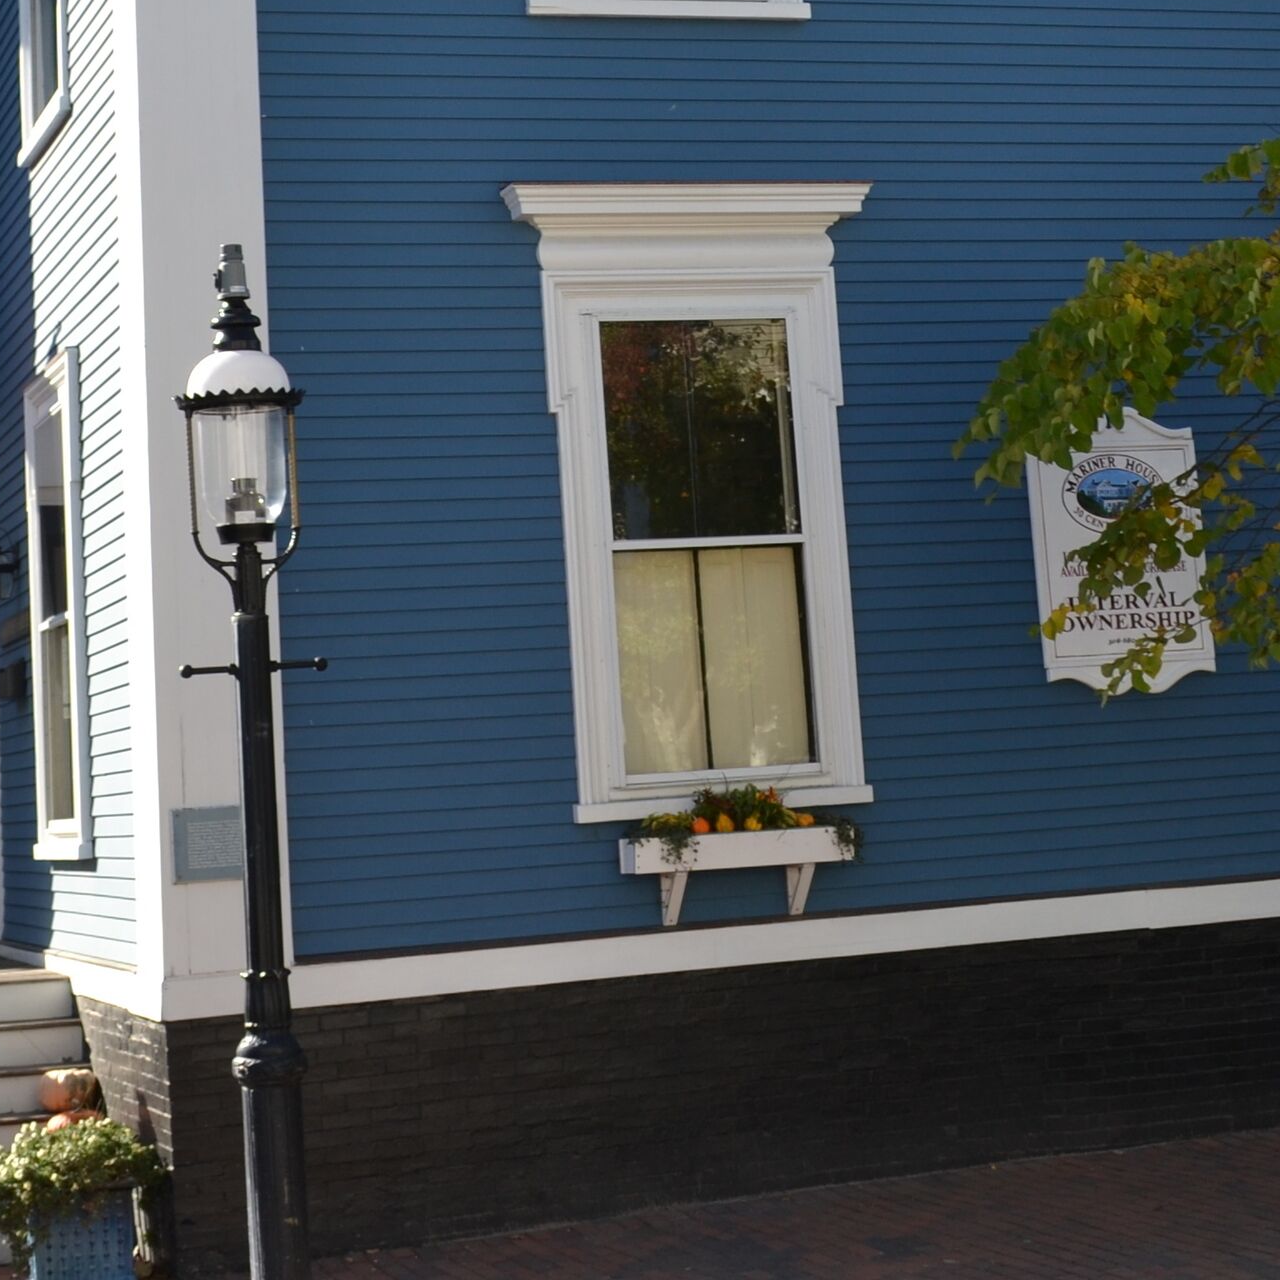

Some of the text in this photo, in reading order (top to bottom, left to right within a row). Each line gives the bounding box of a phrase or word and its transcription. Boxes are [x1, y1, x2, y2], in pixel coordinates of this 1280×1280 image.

[1065, 456, 1159, 494] MARINER HOUS
[1068, 591, 1182, 613] ITERVAL
[1063, 610, 1196, 633] OWNERSHIP
